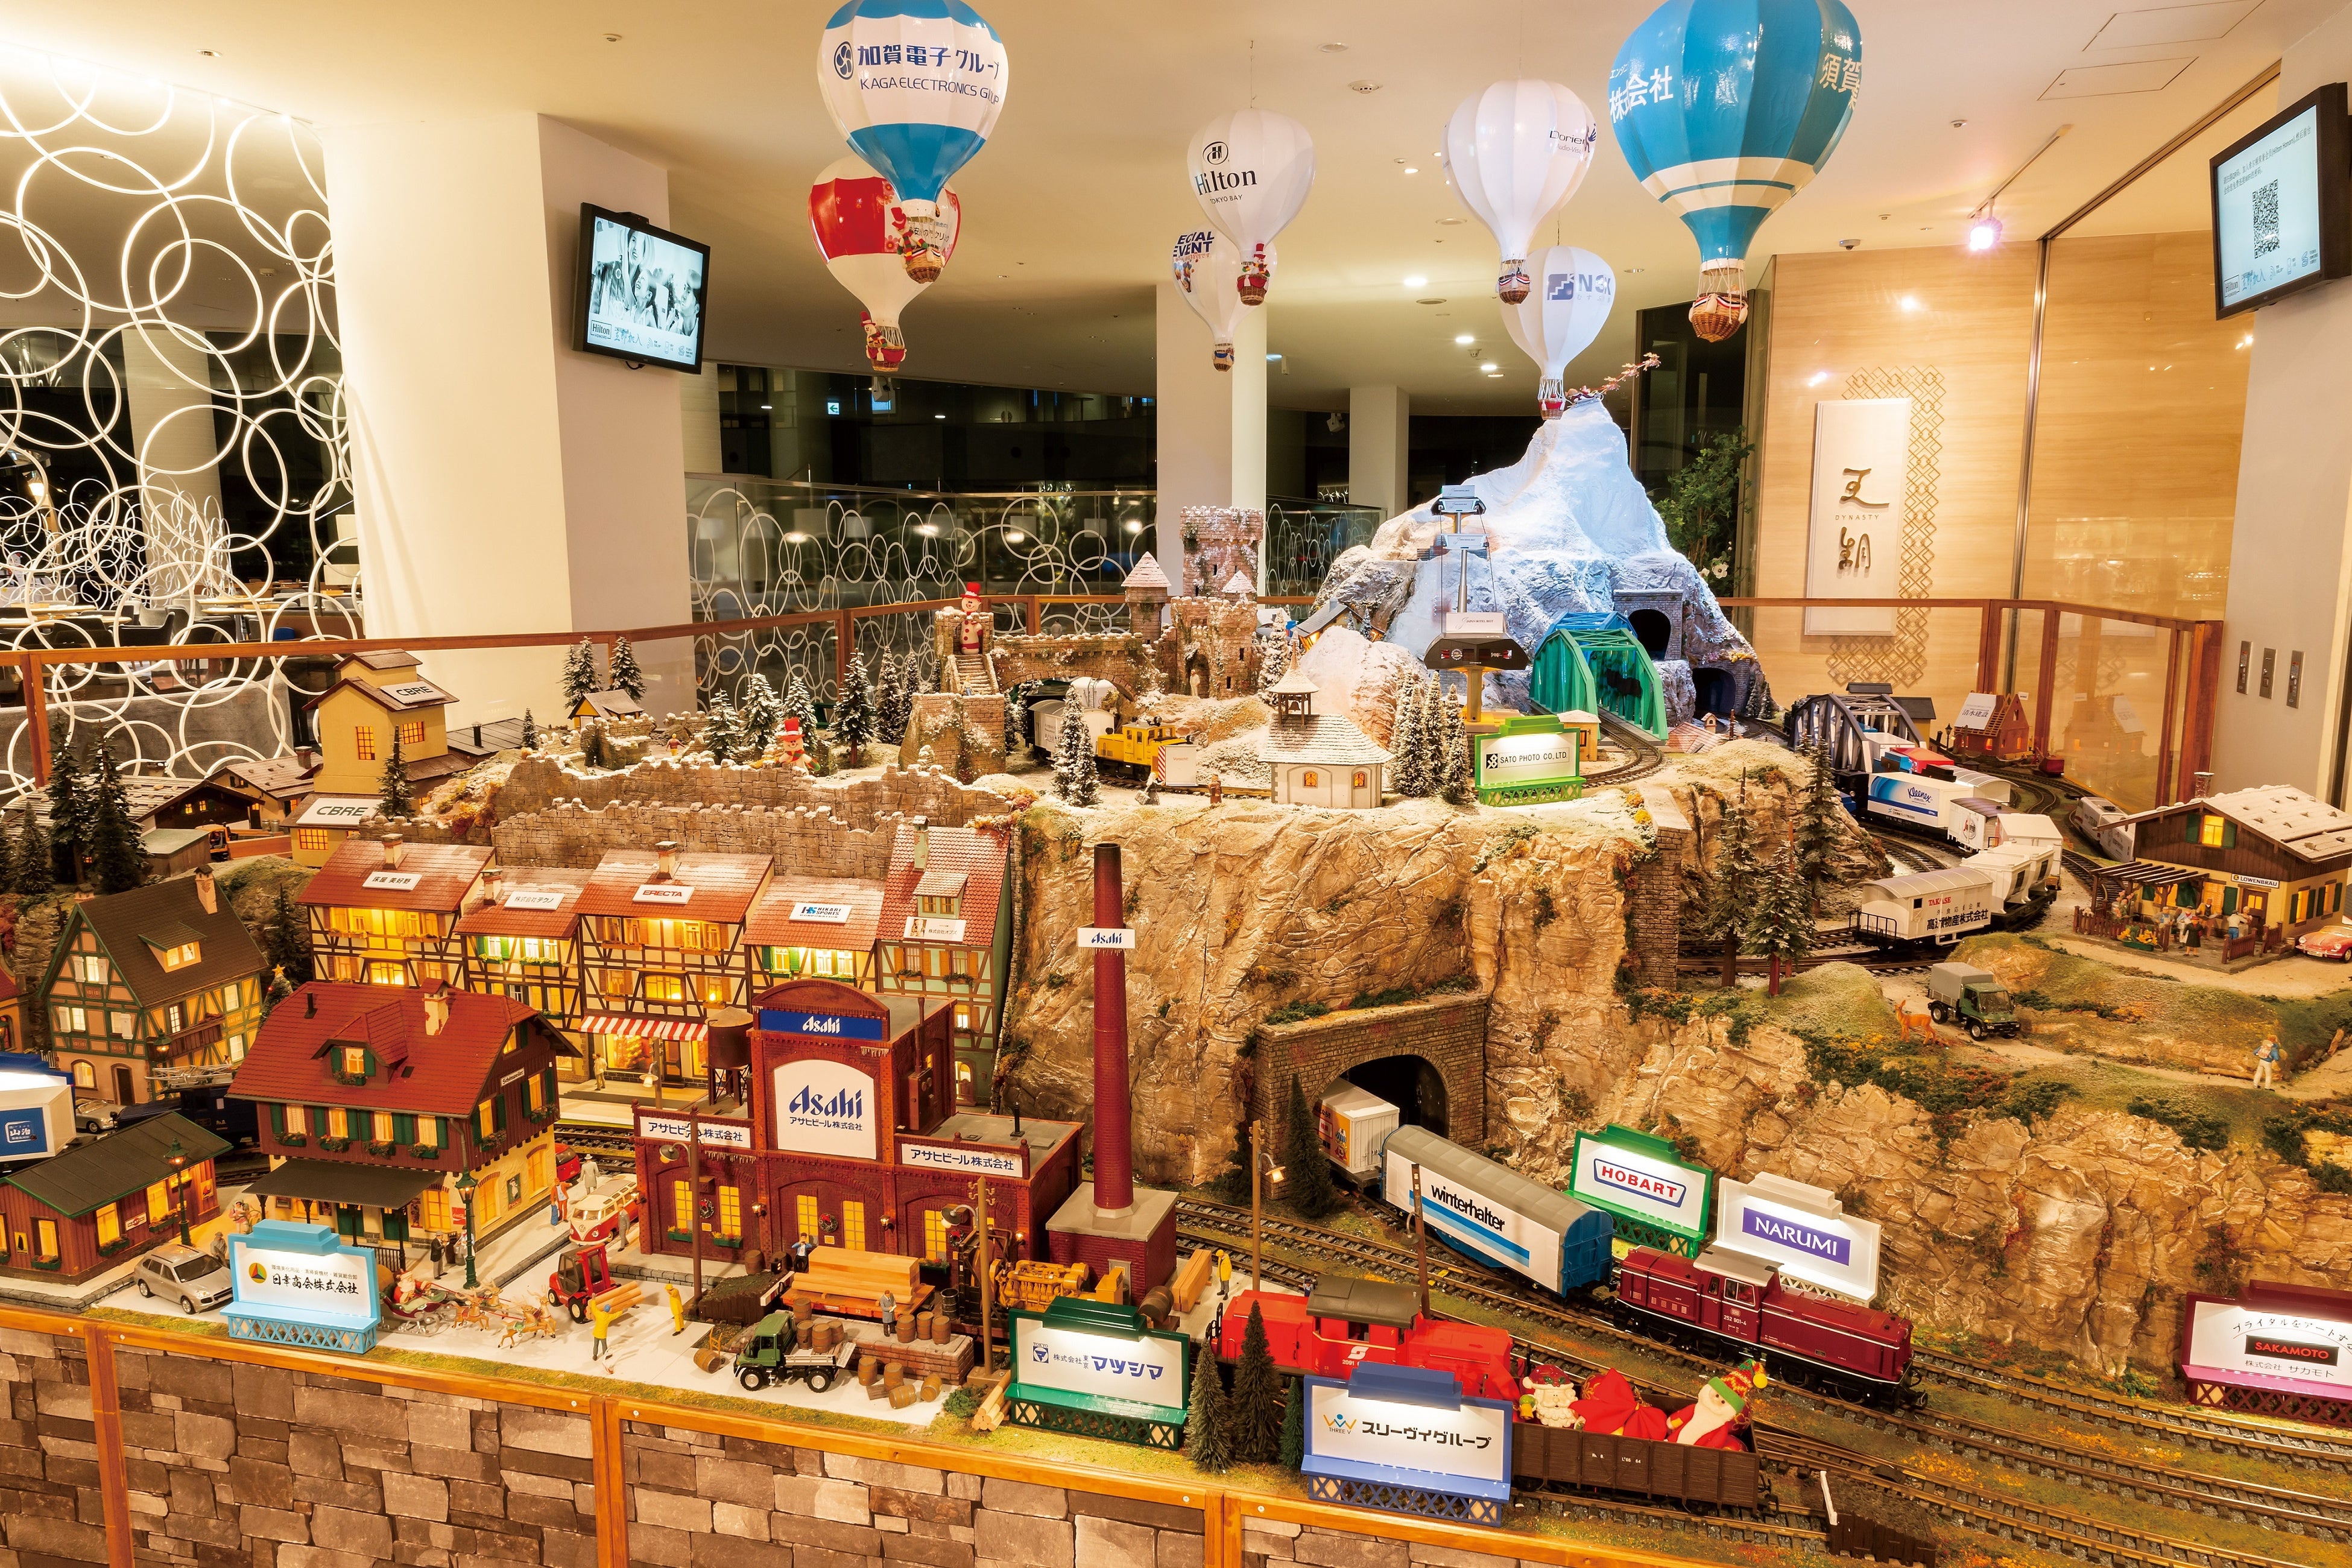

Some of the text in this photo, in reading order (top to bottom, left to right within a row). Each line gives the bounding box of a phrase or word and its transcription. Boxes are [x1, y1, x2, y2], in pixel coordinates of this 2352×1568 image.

[861, 77, 897, 90] KAGA
[899, 77, 977, 96] ELECTRONICS
[1609, 66, 1674, 124] 株式会社
[1195, 169, 1257, 196] Hilton
[1173, 241, 1213, 257] EVENT
[2225, 281, 2239, 293] Hilton
[592, 323, 610, 335] Hilton
[396, 686, 433, 696] CBRE
[1519, 754, 1540, 762] PHOTO
[1908, 787, 1931, 803] Kleenex
[316, 806, 368, 817] CBRE
[1091, 932, 1122, 944] Asahi
[802, 1016, 840, 1034] Asahi
[789, 1085, 862, 1119] Asahi
[648, 1122, 743, 1142] アサヒビ株式会社
[789, 1116, 863, 1131] アサヒビール株式会社
[911, 1149, 1014, 1171] アサヒビール株式会社
[1601, 1166, 1677, 1198] HOBART
[1431, 1184, 1505, 1231] winterhalter
[1755, 1216, 1838, 1256] NARUMI
[272, 1273, 359, 1295] 日幸商会株式会社
[2254, 1341, 2330, 1359] SAKAMOTO
[1053, 1353, 1083, 1365] 株式会社
[1091, 1355, 1164, 1380] マツシマ
[2245, 1360, 2335, 1378] 株式会社 サカモト
